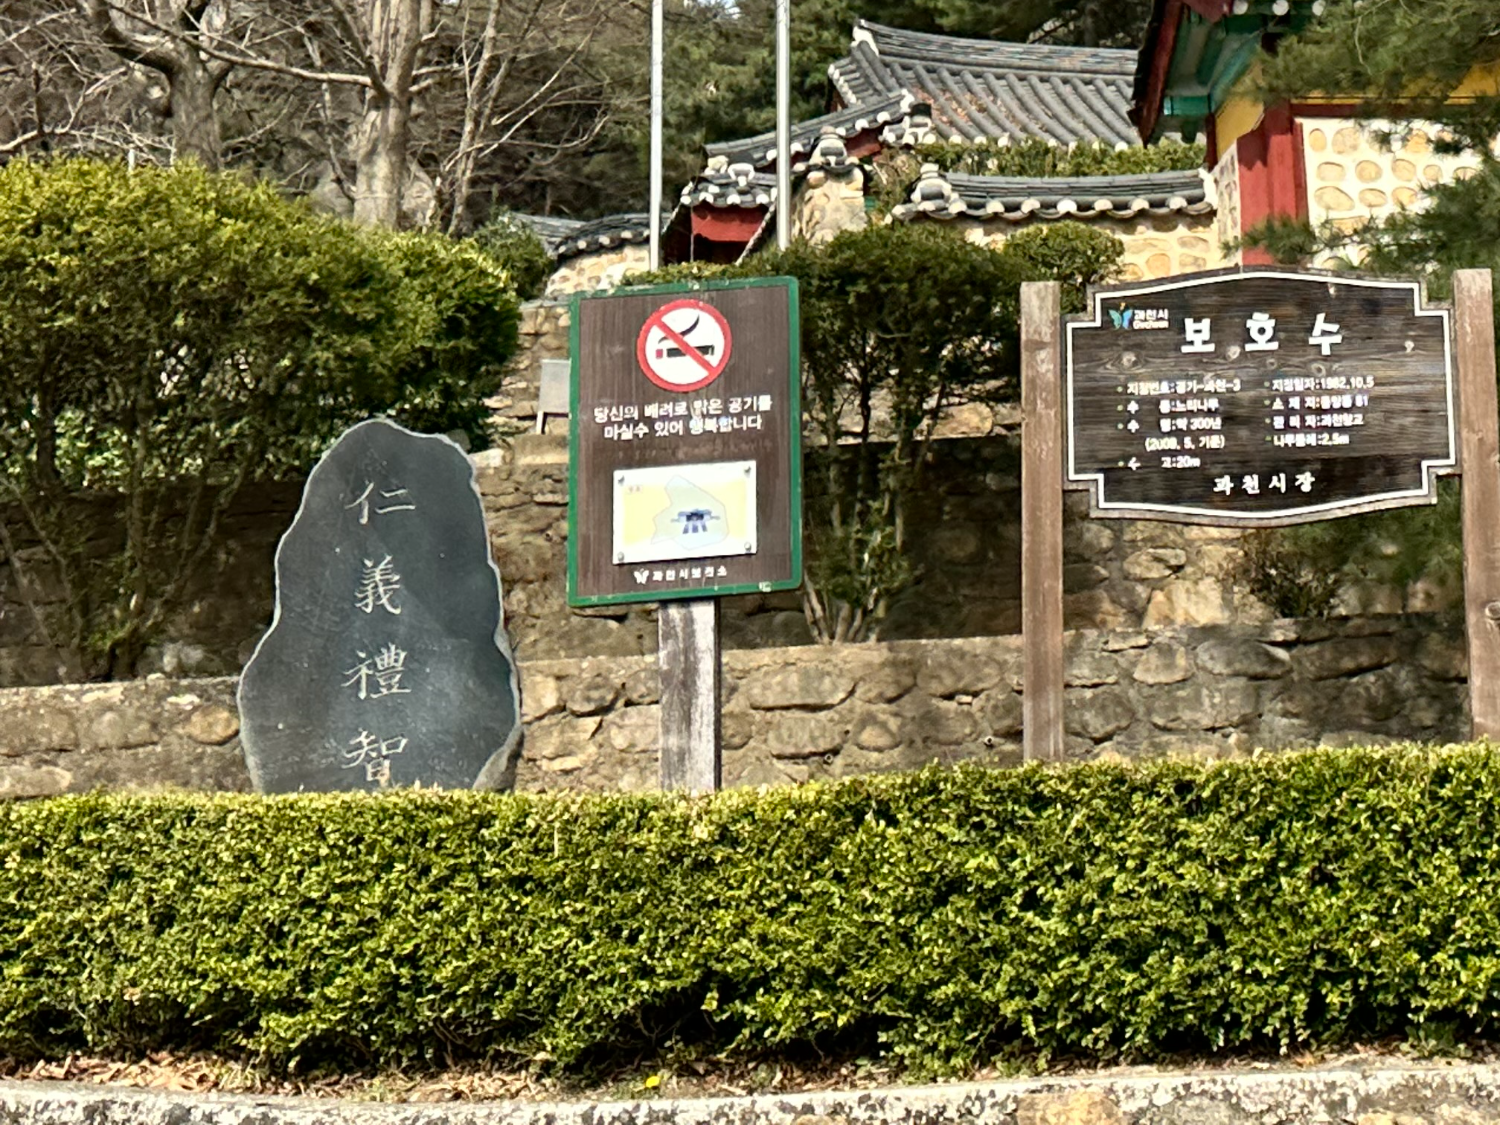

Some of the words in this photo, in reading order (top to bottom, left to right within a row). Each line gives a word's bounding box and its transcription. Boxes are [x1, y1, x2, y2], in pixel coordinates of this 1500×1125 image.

[1134, 309, 1168, 320] 과천시
[593, 405, 639, 423] 당신의
[644, 401, 689, 419] 배려로
[693, 398, 724, 416] 맑은
[728, 395, 773, 413] 공기를
[604, 422, 650, 441] 마실수
[654, 420, 685, 437] 있어
[689, 414, 763, 435] 행복합니다
[1190, 417, 1222, 430] 300년
